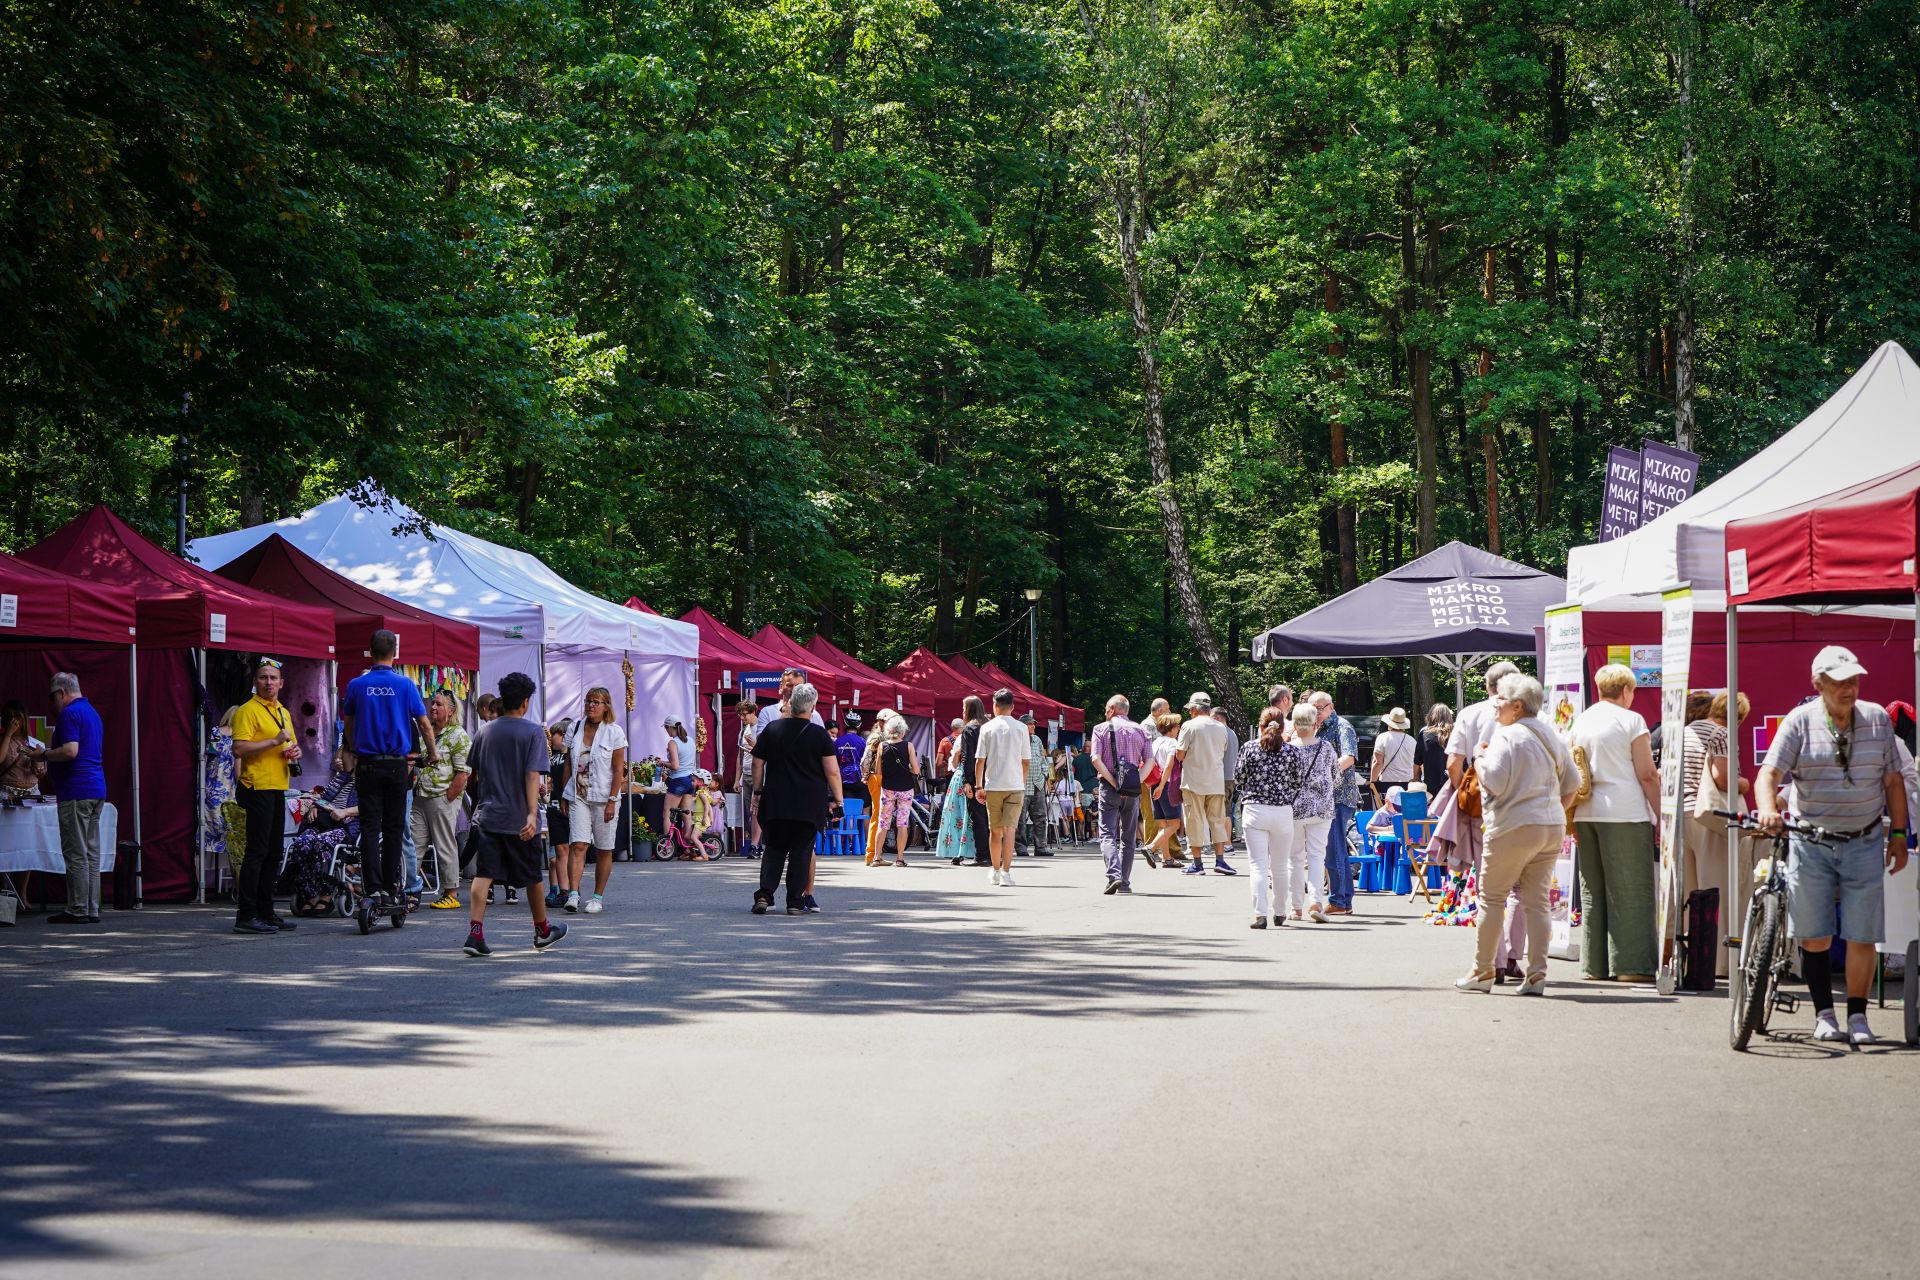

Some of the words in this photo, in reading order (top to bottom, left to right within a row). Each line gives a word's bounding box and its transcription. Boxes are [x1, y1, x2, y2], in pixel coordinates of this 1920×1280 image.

[1611, 462, 1639, 485] MIK
[1645, 458, 1691, 483] MIKRO
[1643, 478, 1687, 503] MAKRO
[1427, 582, 1501, 596] MIKRO
[1429, 593, 1504, 607] MAKRO
[1431, 604, 1507, 617] METRO
[1433, 615, 1511, 628] POLIA
